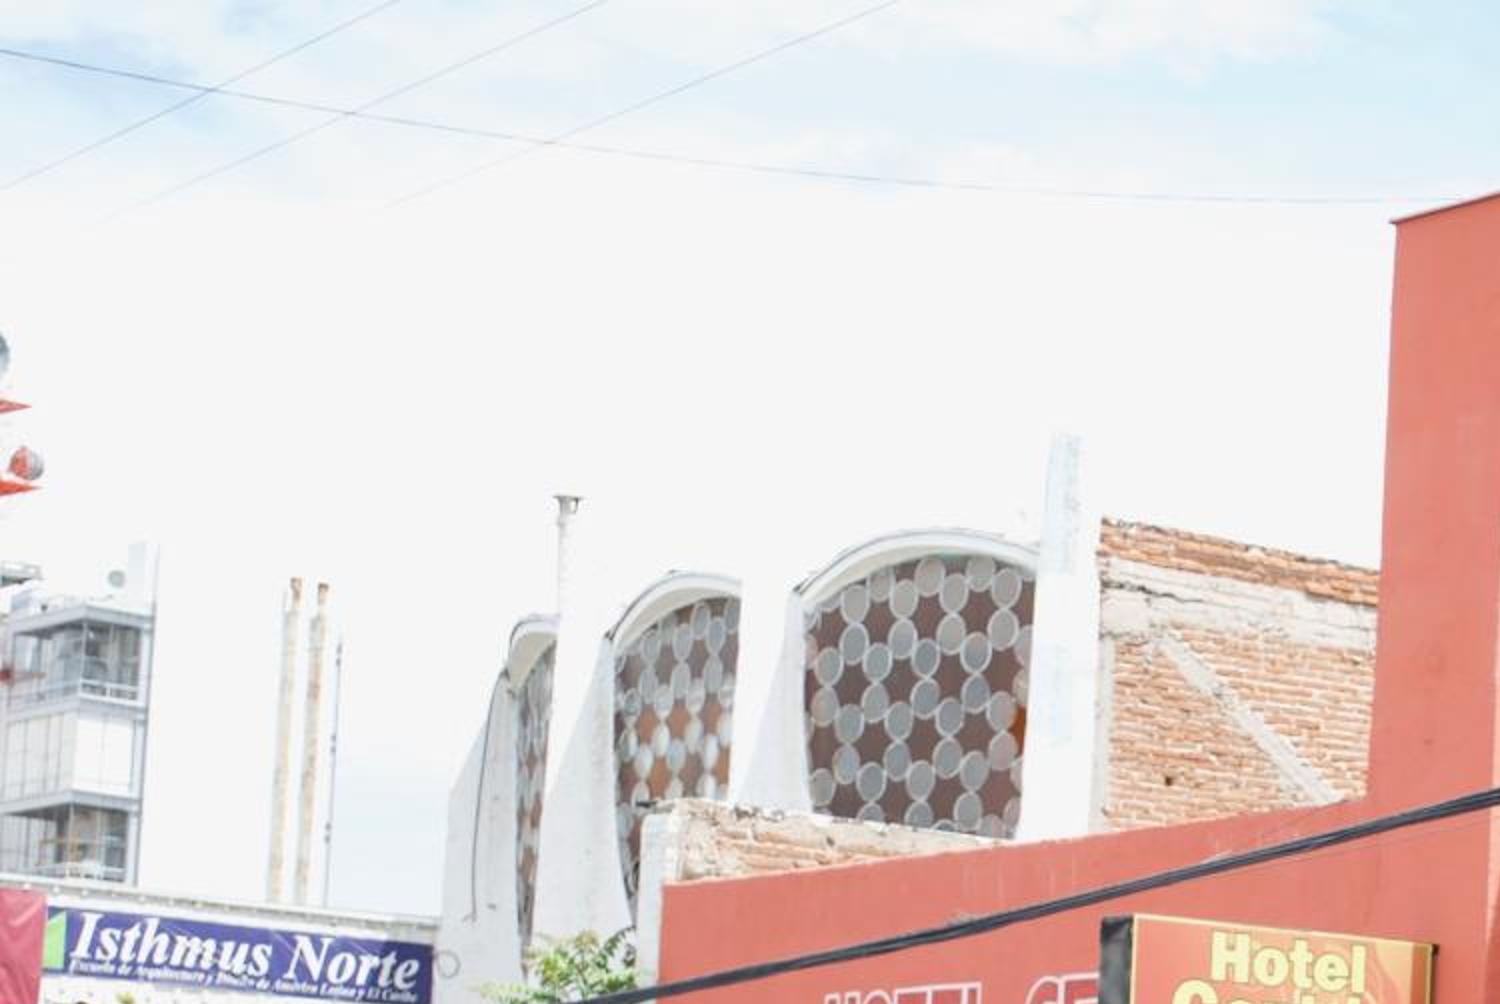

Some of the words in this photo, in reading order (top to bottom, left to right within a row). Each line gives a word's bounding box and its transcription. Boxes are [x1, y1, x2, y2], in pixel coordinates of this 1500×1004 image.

[70, 911, 273, 977] Isthmus
[283, 934, 420, 991] Norte
[1208, 930, 1367, 994] Hotel
